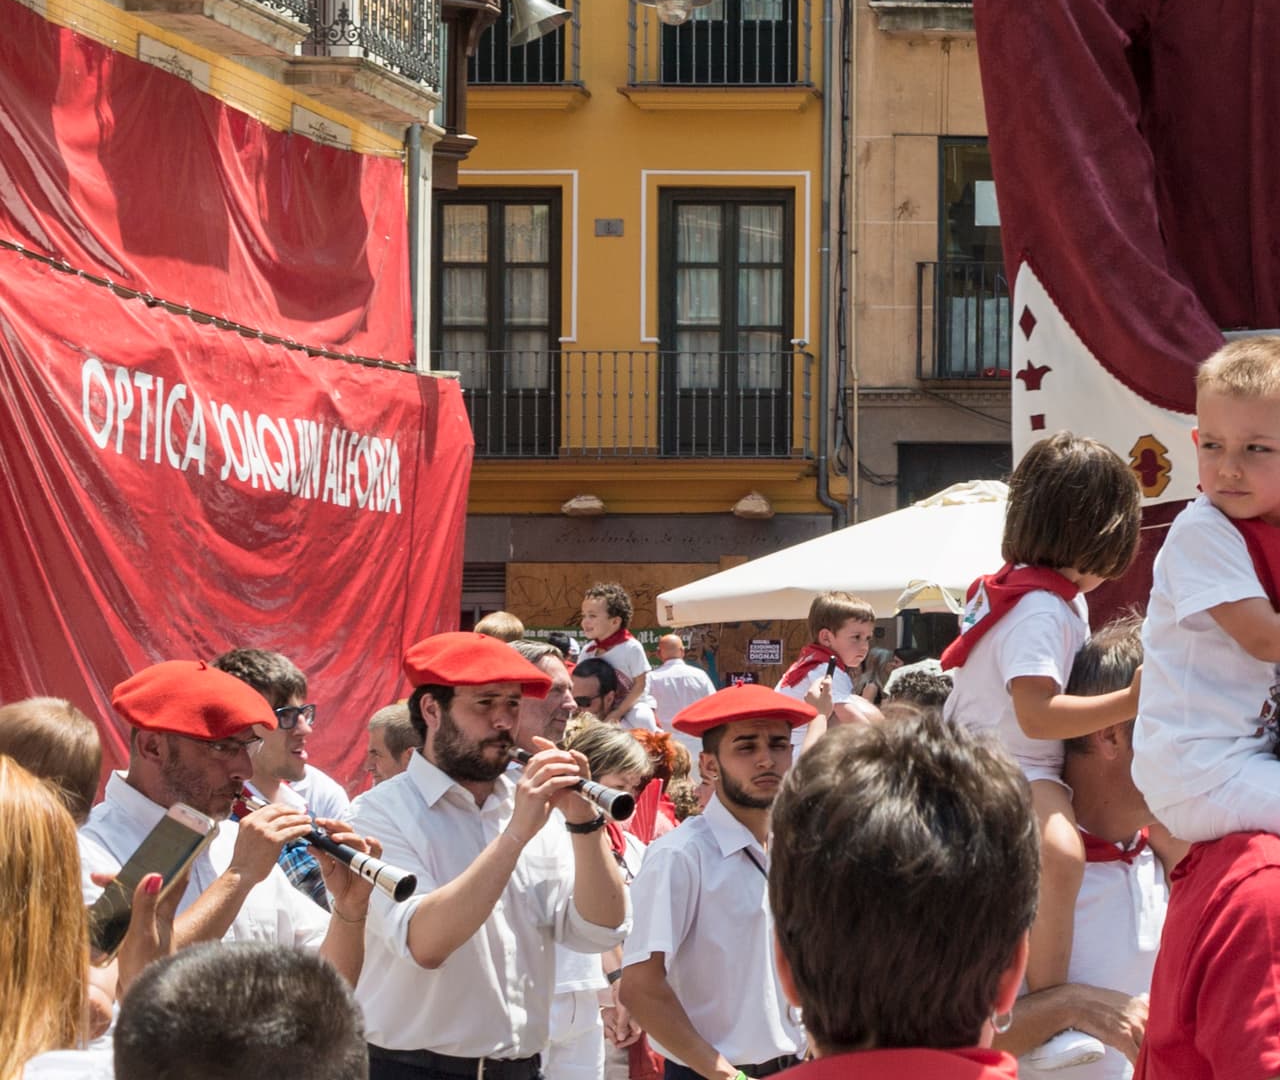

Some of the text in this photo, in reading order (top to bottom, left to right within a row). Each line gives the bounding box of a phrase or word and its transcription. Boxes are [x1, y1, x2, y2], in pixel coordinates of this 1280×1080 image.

[81, 358, 402, 515] OPTICA JOAQUIN ALFORJA
